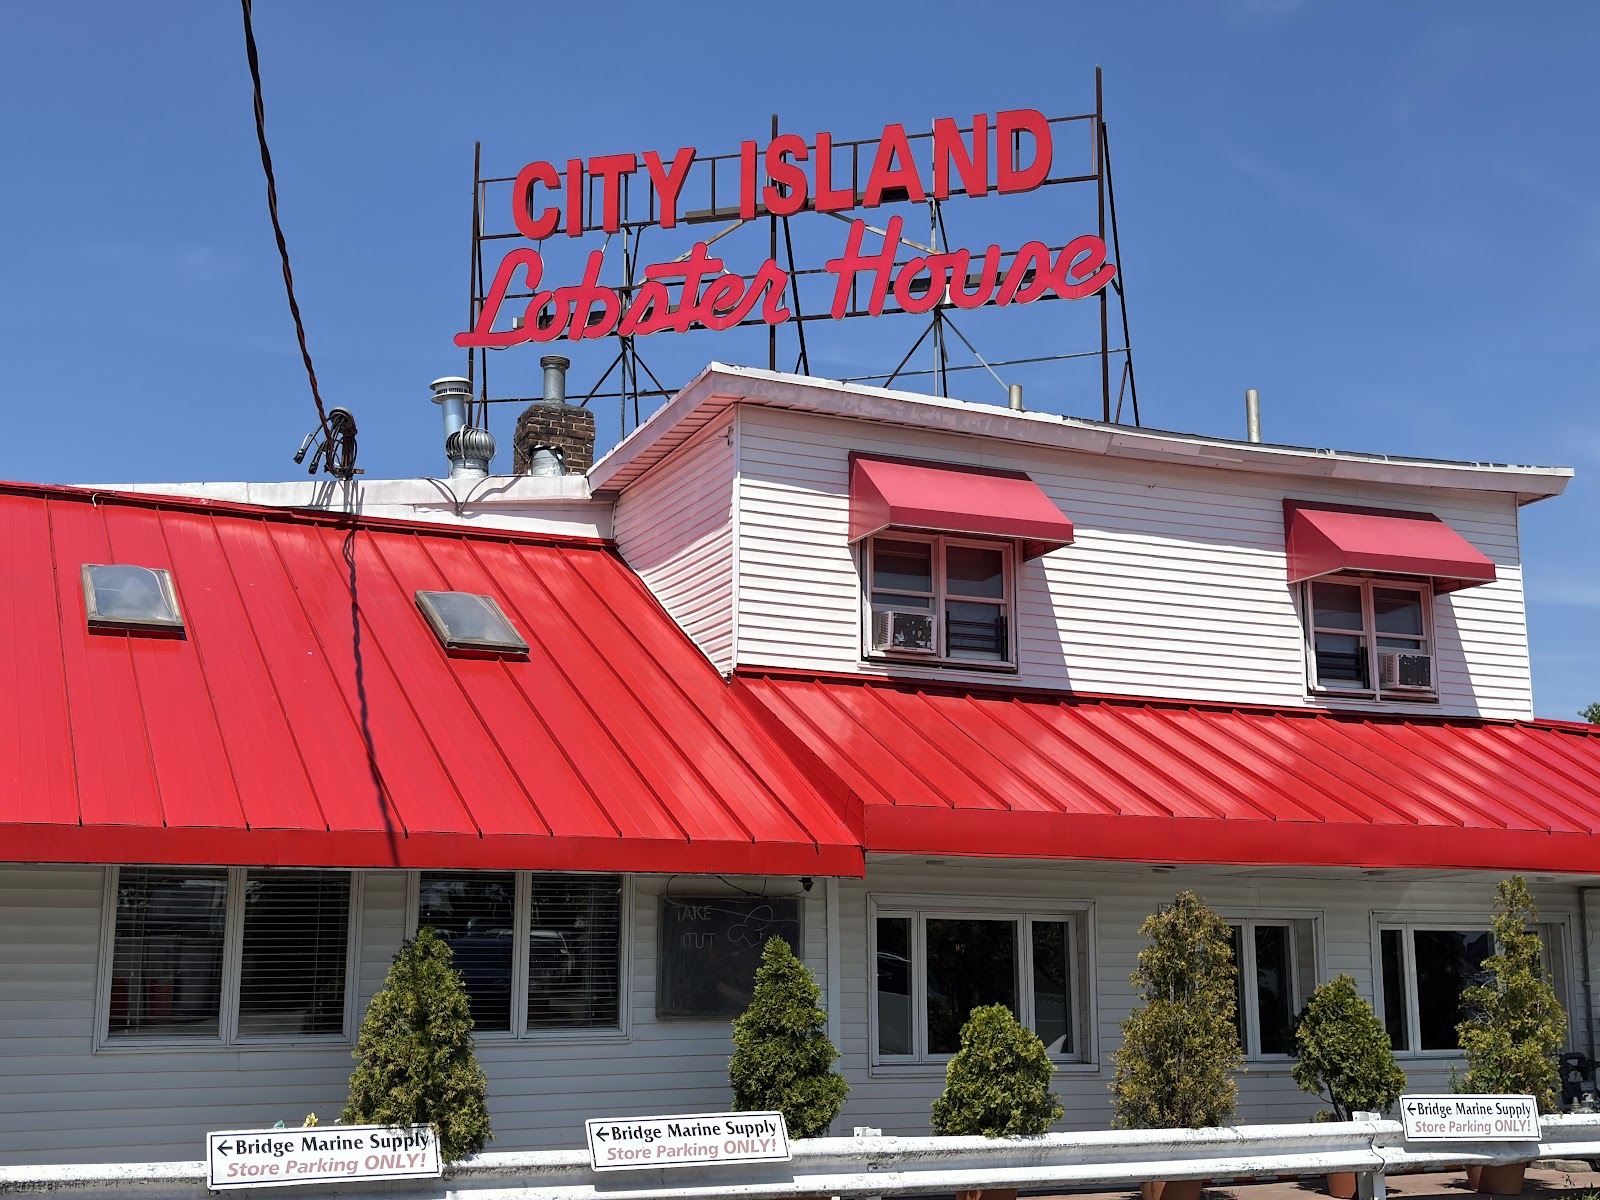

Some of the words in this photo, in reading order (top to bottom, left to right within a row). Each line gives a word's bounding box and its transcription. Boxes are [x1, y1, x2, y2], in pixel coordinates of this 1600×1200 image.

[512, 147, 696, 240] CITY
[739, 108, 1053, 219] ISLAND
[453, 242, 791, 348] Lobster
[825, 215, 1117, 320] House
[674, 905, 713, 922] TAKE
[682, 932, 715, 949] OUT
[1417, 1102, 1452, 1118] Bridge
[1456, 1102, 1493, 1115] Marine
[1495, 1102, 1531, 1118] Supply
[611, 1125, 662, 1142] Bridge
[667, 1122, 721, 1138] Marine
[726, 1119, 777, 1138] Supply
[1415, 1121, 1446, 1133] Store
[1449, 1120, 1492, 1135] Parking
[1495, 1119, 1531, 1132] ONLY!
[235, 1138, 294, 1157] Bridge
[301, 1135, 364, 1152] Marine
[369, 1131, 430, 1151] Supply
[607, 1146, 652, 1161] Store
[656, 1143, 719, 1158] Parking
[723, 1138, 777, 1155] ONLY!
[227, 1162, 280, 1178] Store
[285, 1157, 358, 1175] Parking
[364, 1152, 427, 1170] ONLY!
